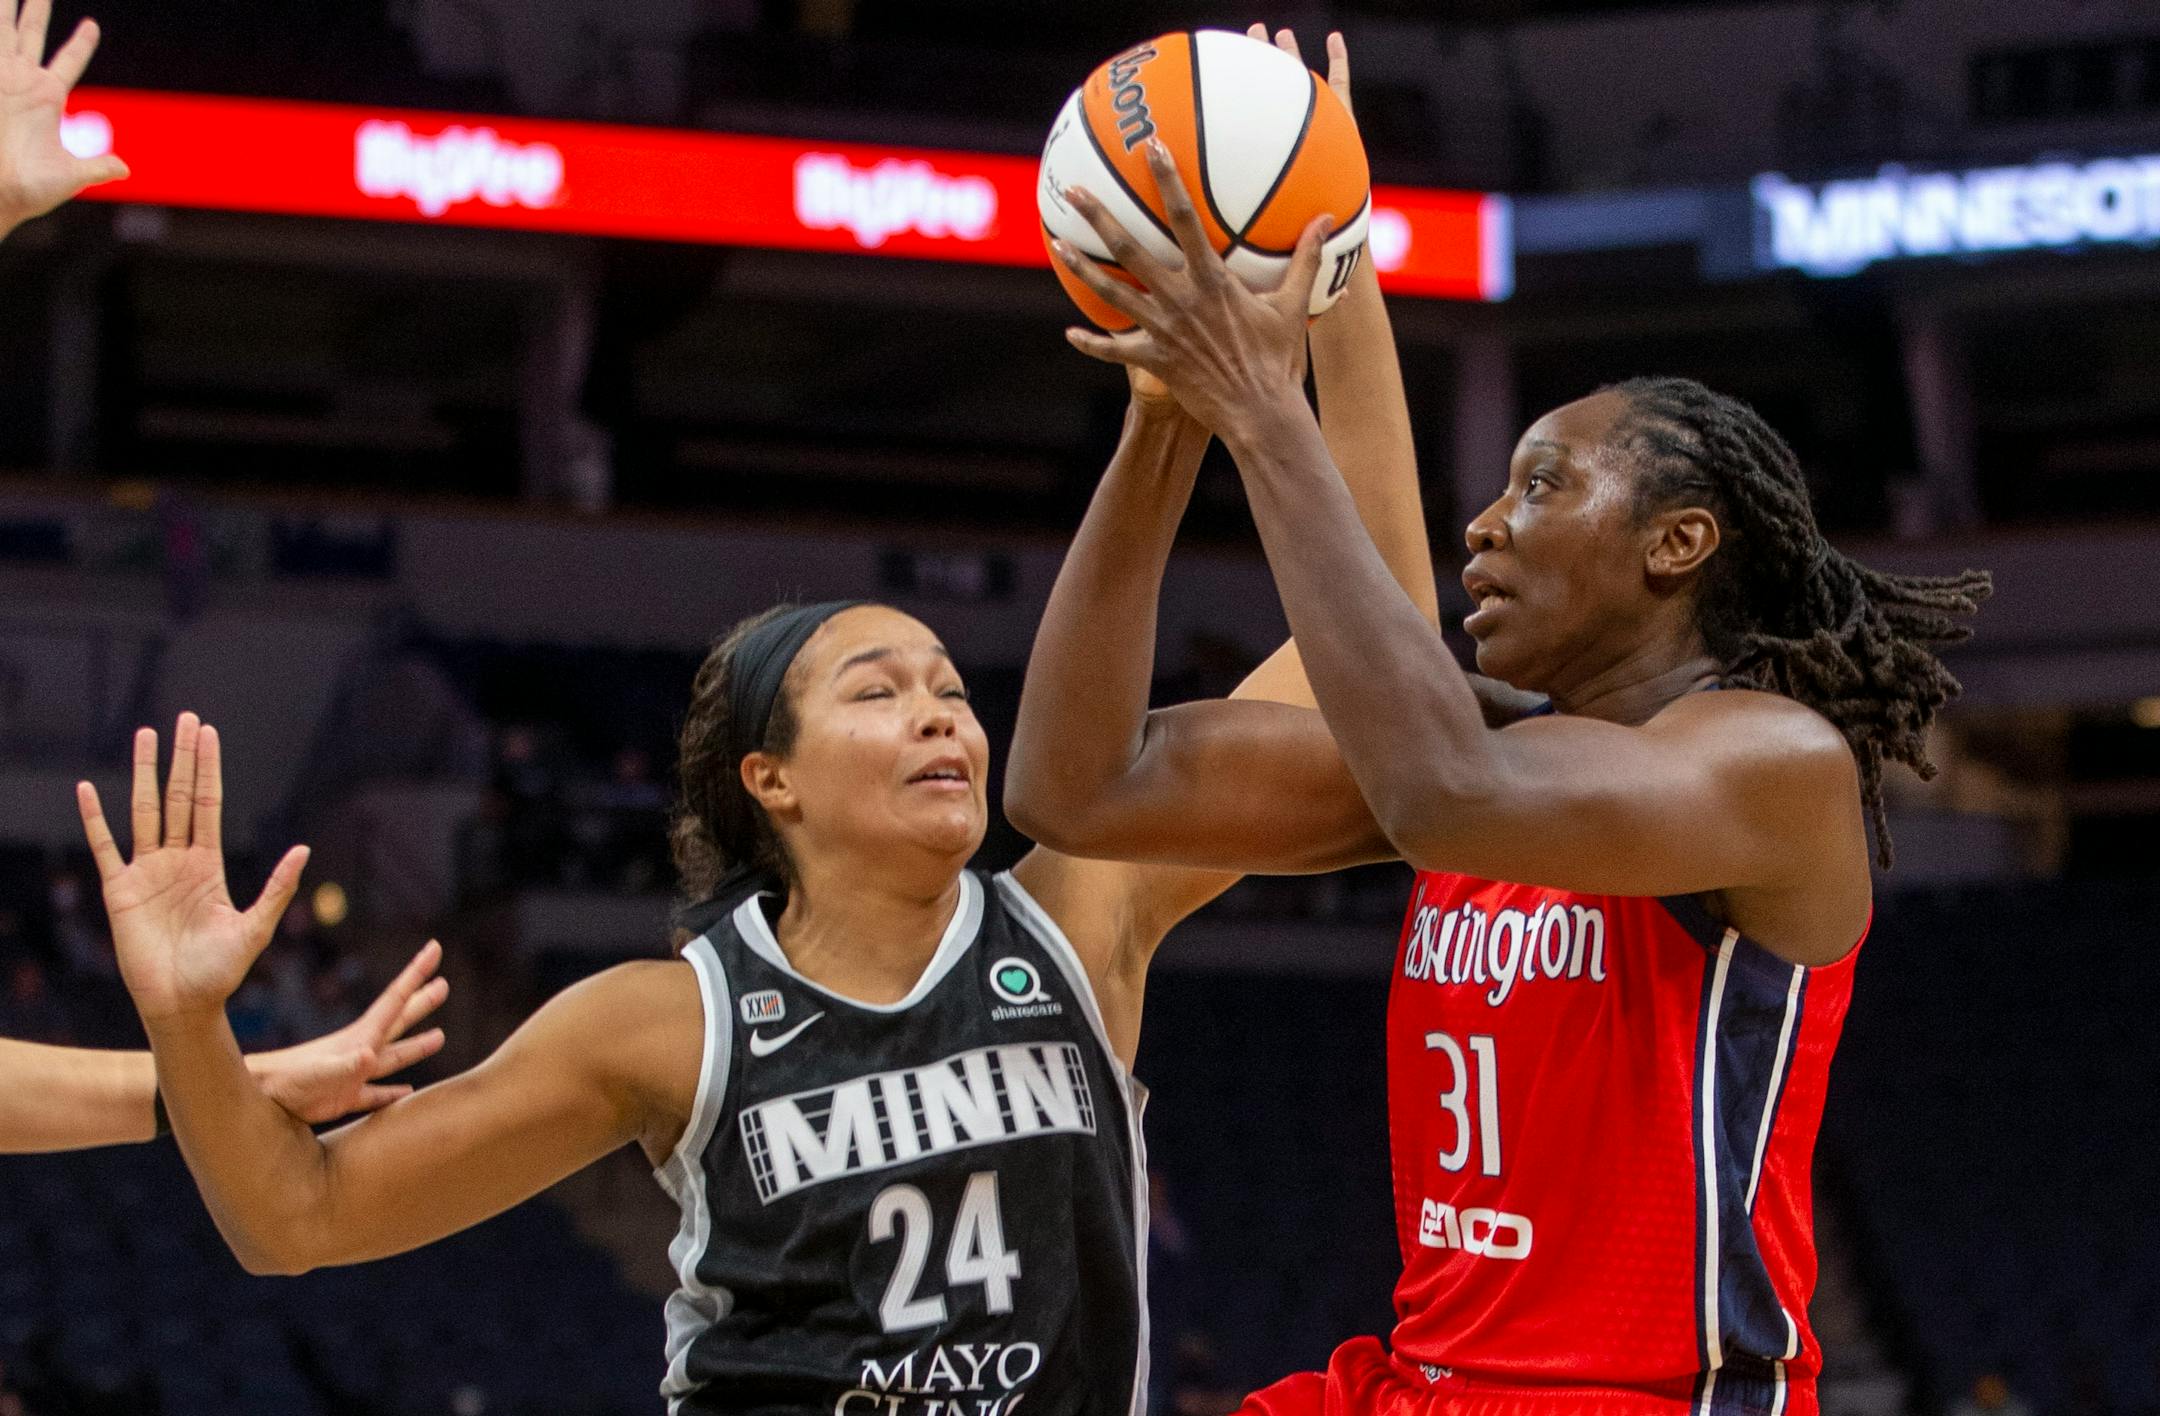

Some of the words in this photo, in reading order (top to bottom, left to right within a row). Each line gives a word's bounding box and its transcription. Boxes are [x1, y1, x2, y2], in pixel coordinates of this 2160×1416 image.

[991, 1002, 1062, 1021] sharecare
[761, 1043, 1082, 1196] MINN
[1424, 1030, 1501, 1178] 31
[868, 1170, 1021, 1334] 24
[856, 1341, 1040, 1393] MAYO
